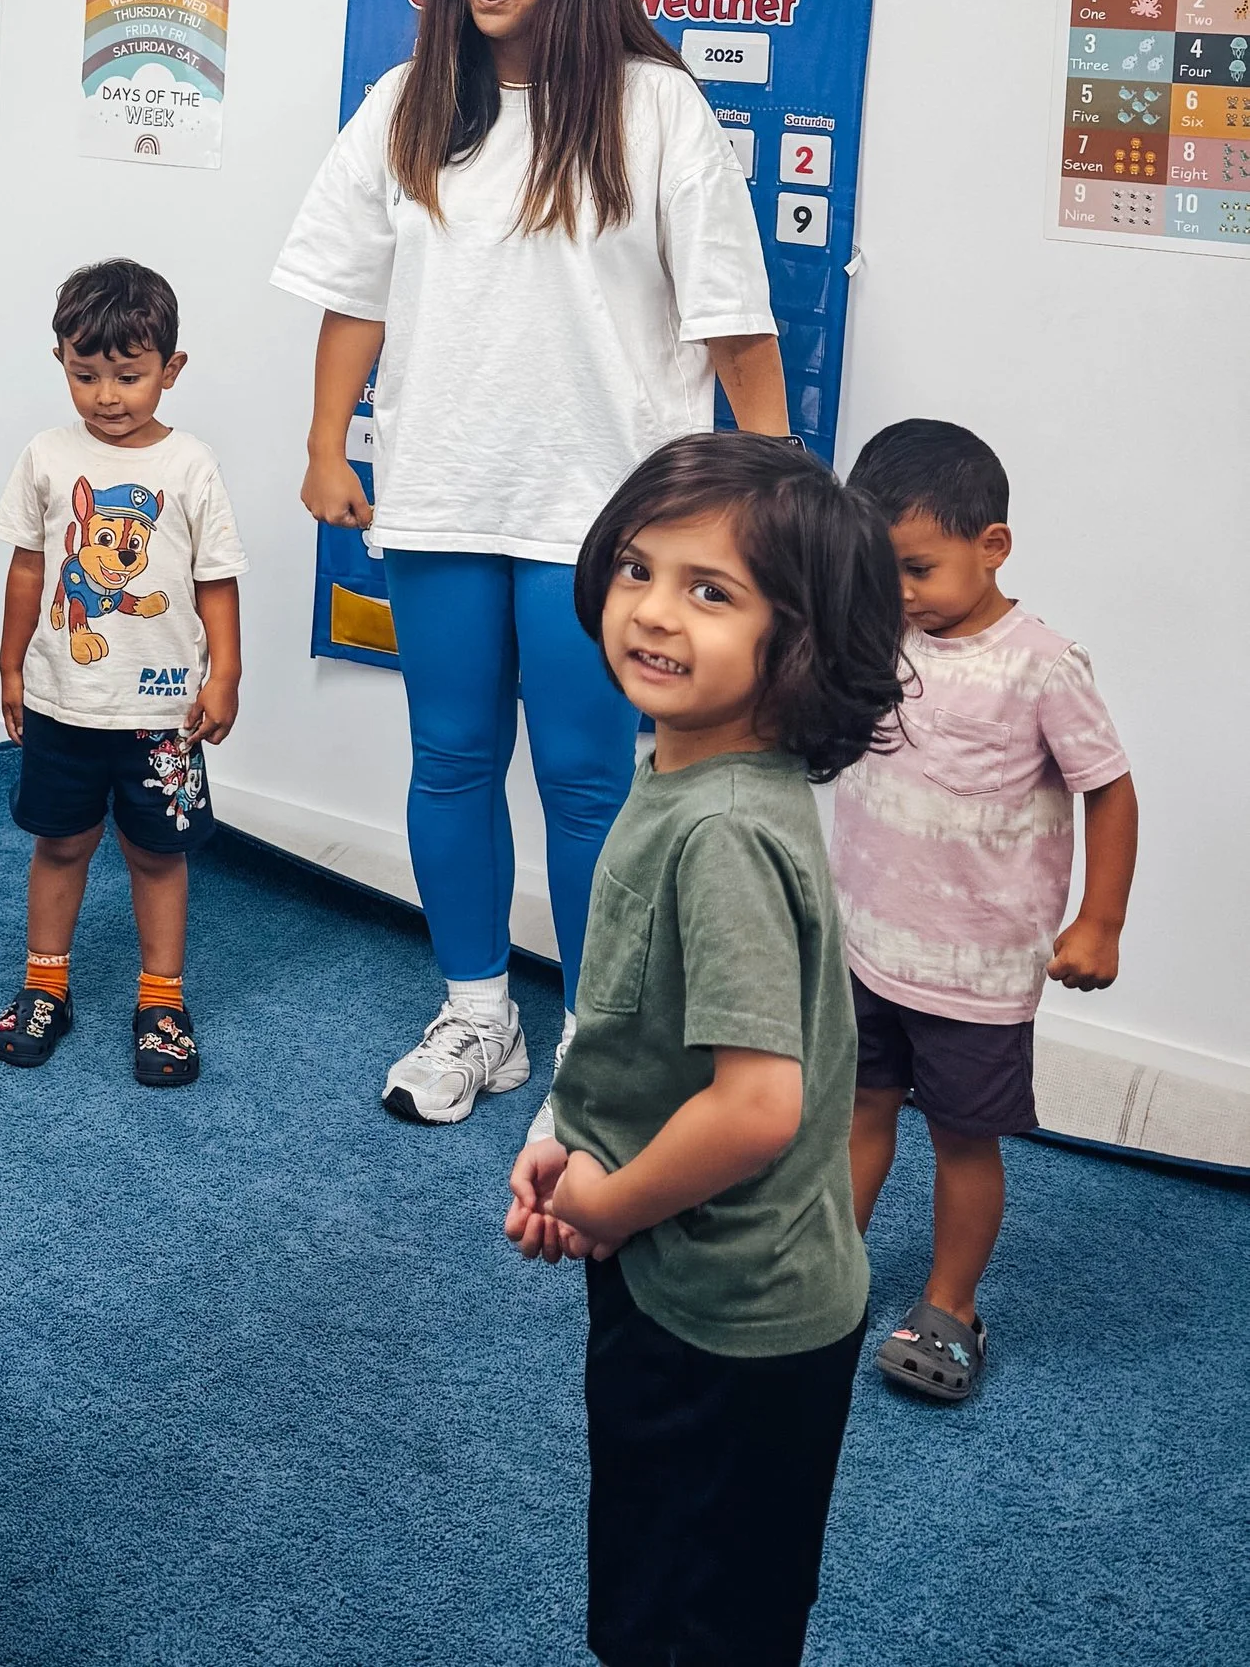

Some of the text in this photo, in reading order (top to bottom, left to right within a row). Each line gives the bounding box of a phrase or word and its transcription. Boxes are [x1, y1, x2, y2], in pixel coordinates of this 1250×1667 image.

[114, 7, 202, 30] THURSDAY THU.
[1080, 8, 1106, 20] One
[1185, 14, 1213, 26] Two
[125, 24, 188, 44] FRIDAY FRI.
[1084, 34, 1096, 53] 3
[1190, 39, 1202, 58] 4
[113, 42, 199, 69] SATURDAY SAT.
[705, 48, 743, 63] 2025
[1070, 58, 1110, 71] Three
[1179, 65, 1212, 78] Four
[103, 86, 200, 107] DAYS OF THE
[1081, 84, 1092, 103] 5
[1186, 90, 1198, 110] 6
[125, 105, 174, 127] WEEK
[717, 110, 749, 123] Friday
[786, 115, 834, 129] Saturday
[1072, 110, 1100, 123] Five
[1181, 116, 1204, 128] Six
[1078, 135, 1088, 154] 7
[1183, 142, 1195, 161] 8
[795, 146, 814, 174] 2
[1063, 159, 1103, 172] Seven
[1171, 166, 1209, 182] Eight
[1074, 184, 1086, 203] 9
[1175, 193, 1198, 214] 10
[793, 206, 812, 233] 9
[1065, 209, 1095, 222] Nine
[1174, 220, 1199, 233] Ten
[140, 668, 190, 685] PAW
[138, 686, 188, 696] PATROL
